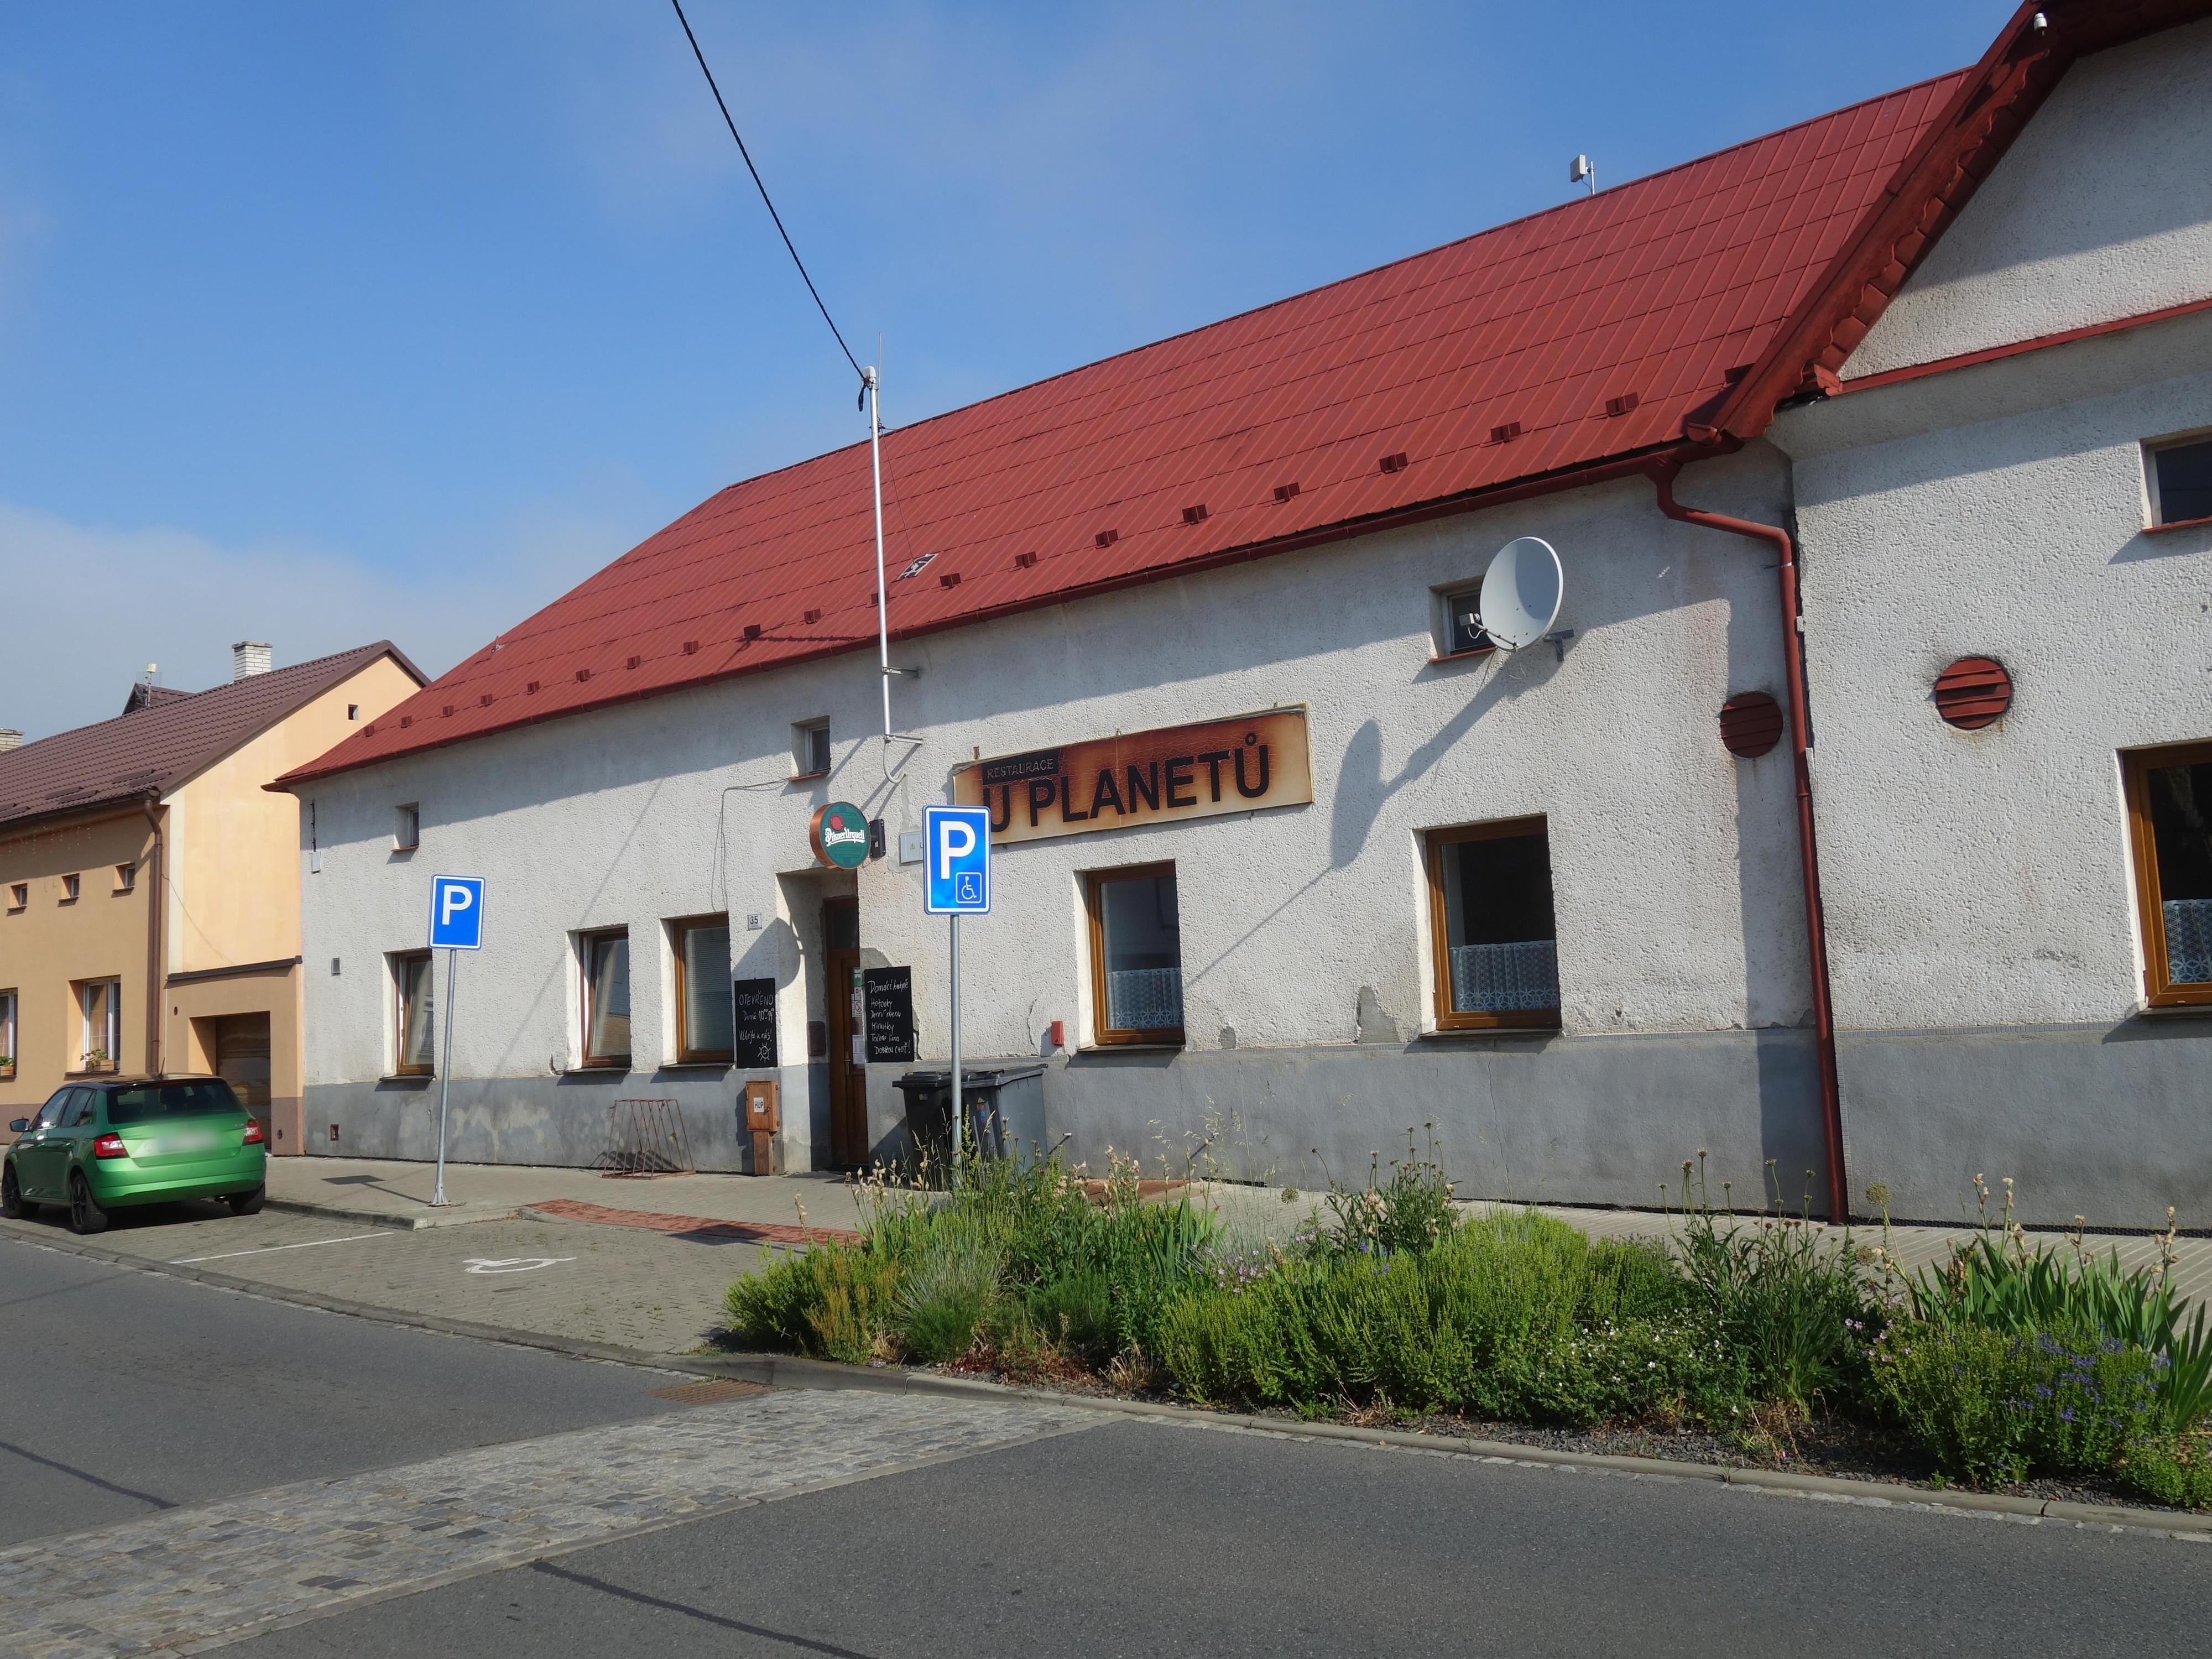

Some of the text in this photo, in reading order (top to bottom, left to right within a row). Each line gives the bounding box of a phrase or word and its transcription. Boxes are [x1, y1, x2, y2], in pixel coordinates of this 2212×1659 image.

[987, 759, 1053, 779] RESTAURACE
[983, 732, 1269, 833] U PLANETŮ
[825, 827, 865, 847] Pilsner Urquell
[940, 821, 976, 879] P
[442, 884, 473, 925] P
[750, 915, 759, 925] 35
[739, 989, 774, 1006] OTEVŘENO
[870, 998, 893, 1012] Hotovky
